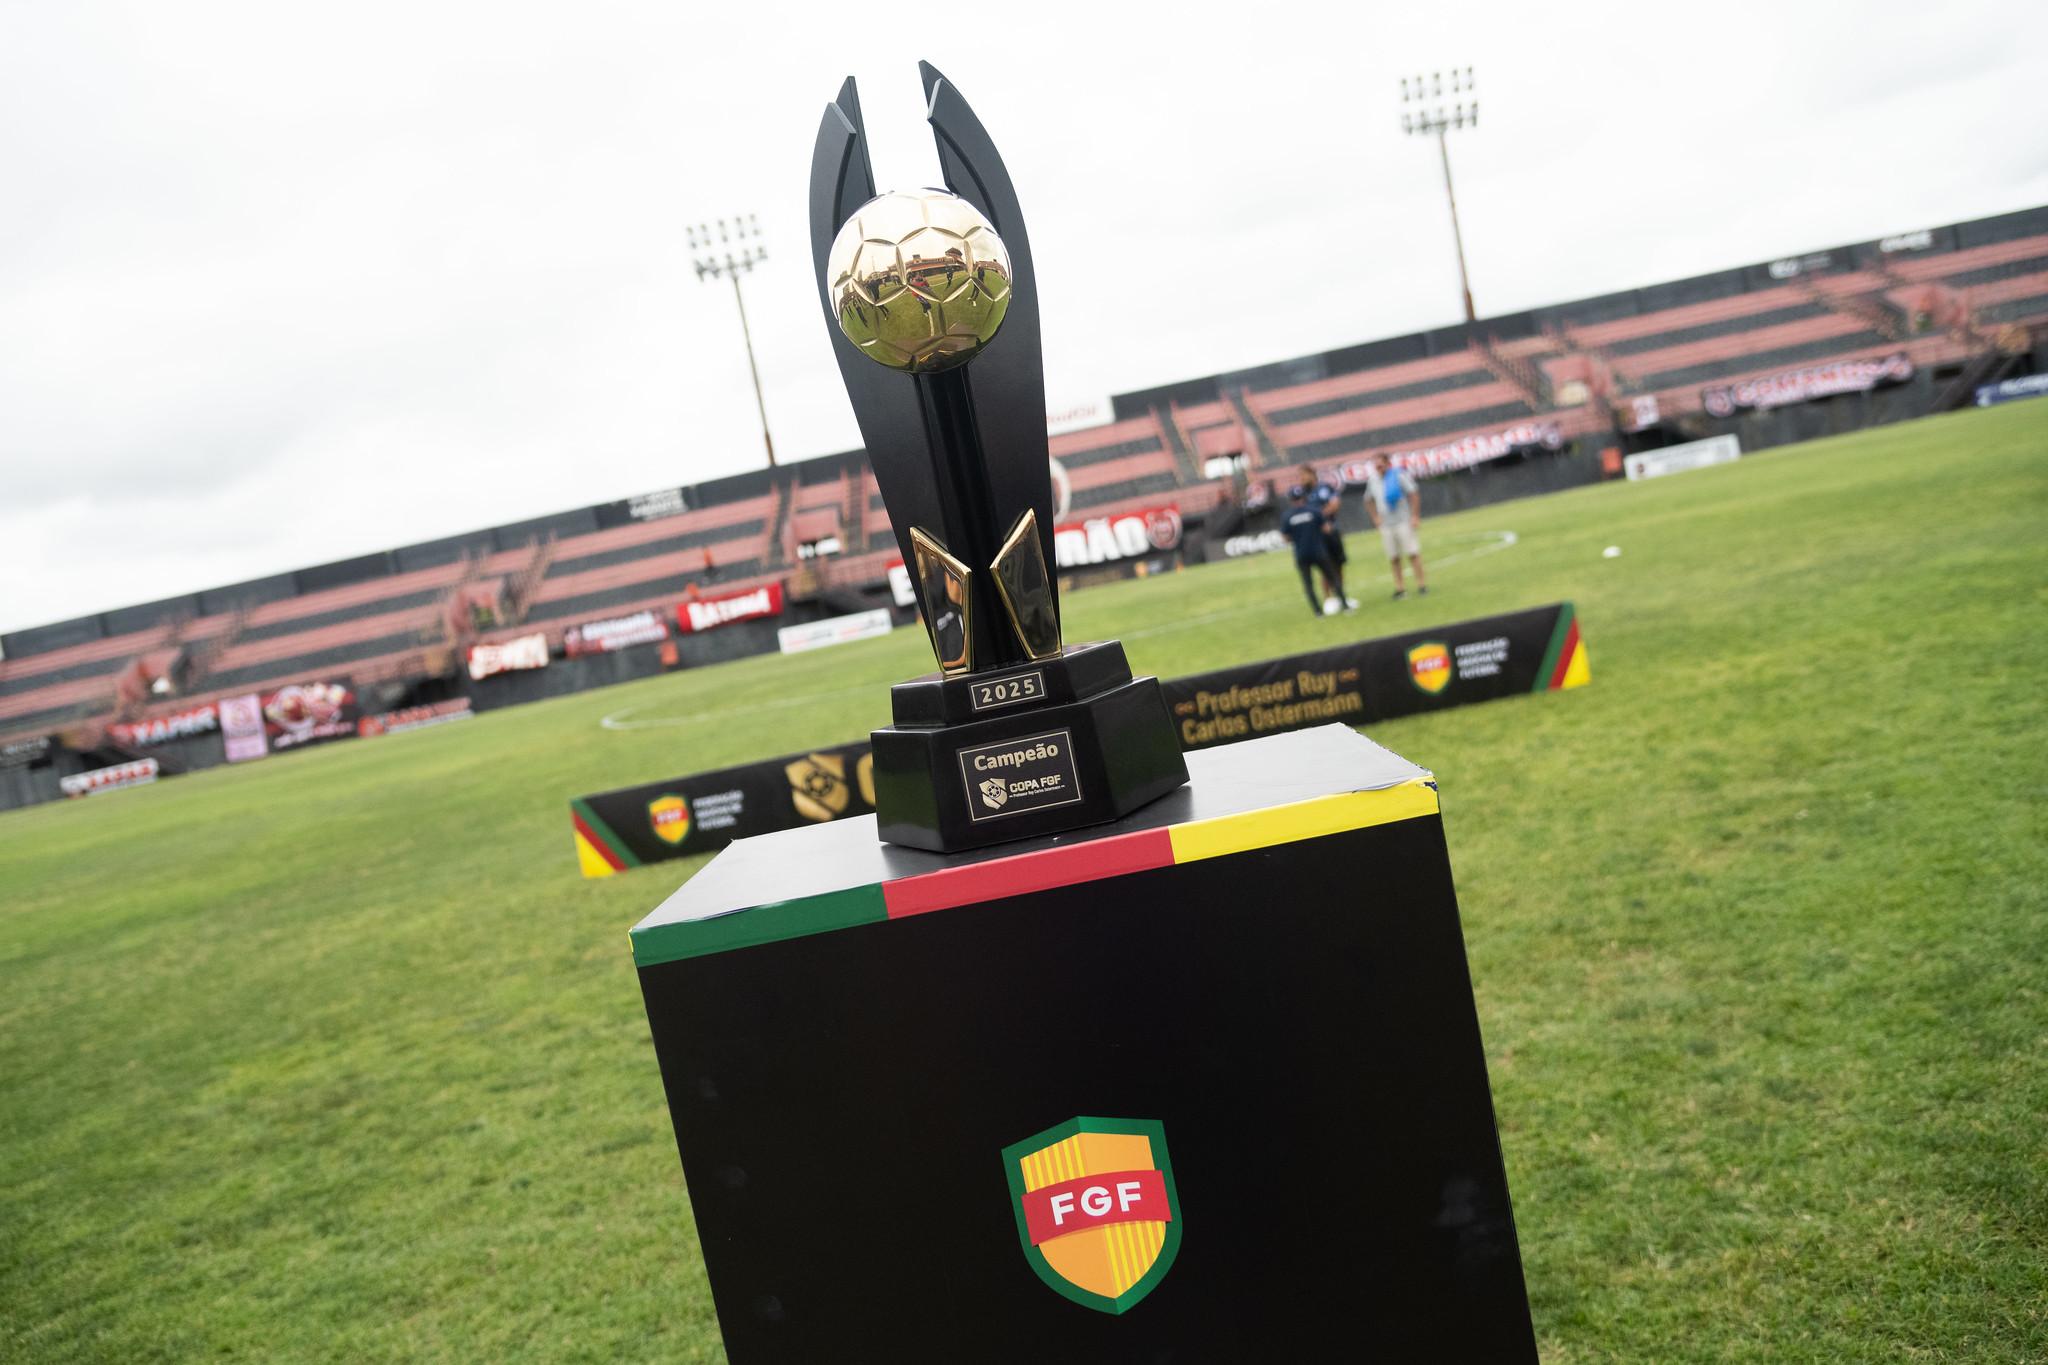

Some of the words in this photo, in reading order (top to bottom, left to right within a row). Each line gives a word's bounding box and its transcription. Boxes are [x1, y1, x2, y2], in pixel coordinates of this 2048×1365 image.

[980, 679, 1035, 703] 2025
[1197, 677, 1295, 717] Professor
[1297, 669, 1338, 698] Ruy
[1182, 712, 1249, 745] Carlos
[1251, 692, 1363, 731] Ostermann
[973, 743, 1059, 771] Campeão
[1009, 780, 1039, 793] COPA
[1040, 774, 1061, 787] FGF
[1050, 1181, 1142, 1226] FGF
